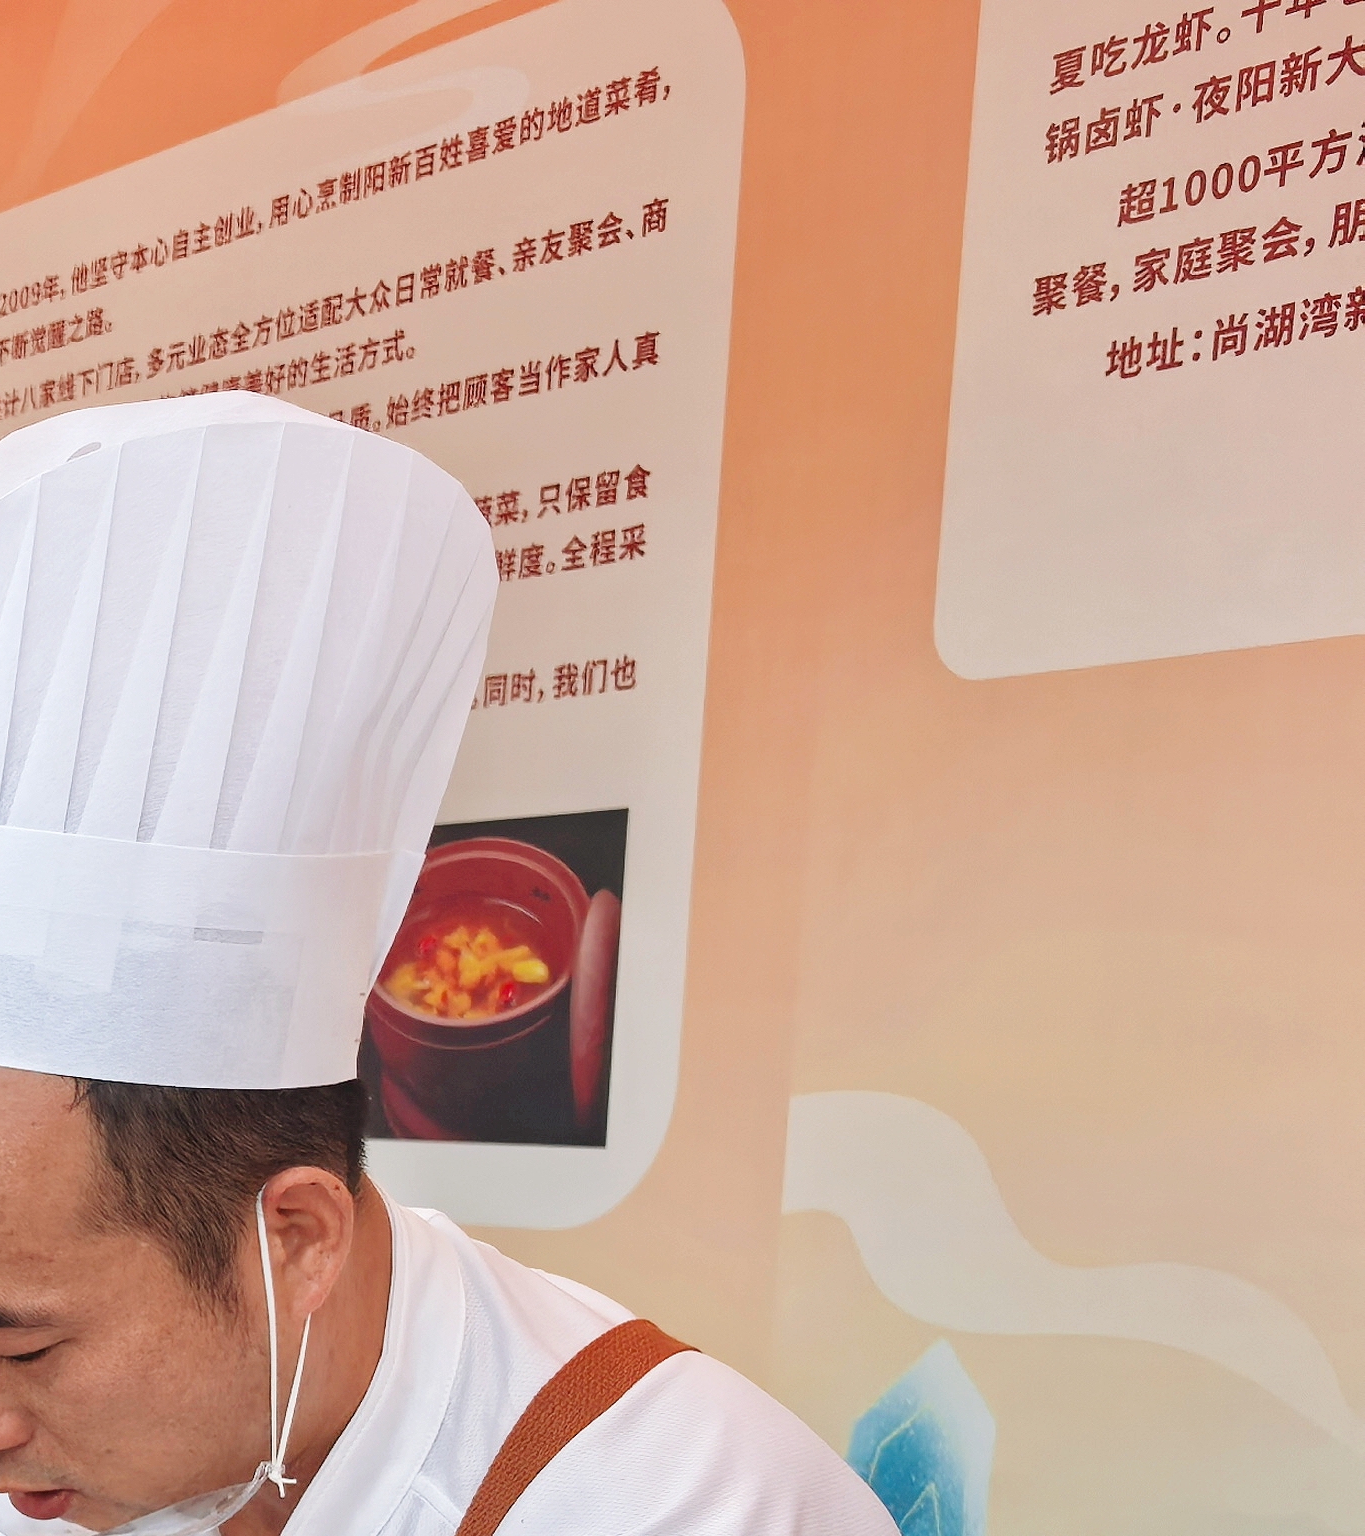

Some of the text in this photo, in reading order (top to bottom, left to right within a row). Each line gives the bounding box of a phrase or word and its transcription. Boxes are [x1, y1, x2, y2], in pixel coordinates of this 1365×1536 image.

[1049, 0, 1365, 95] 夏吃龙虾。十
[1117, 122, 1365, 228] 超1000平方
